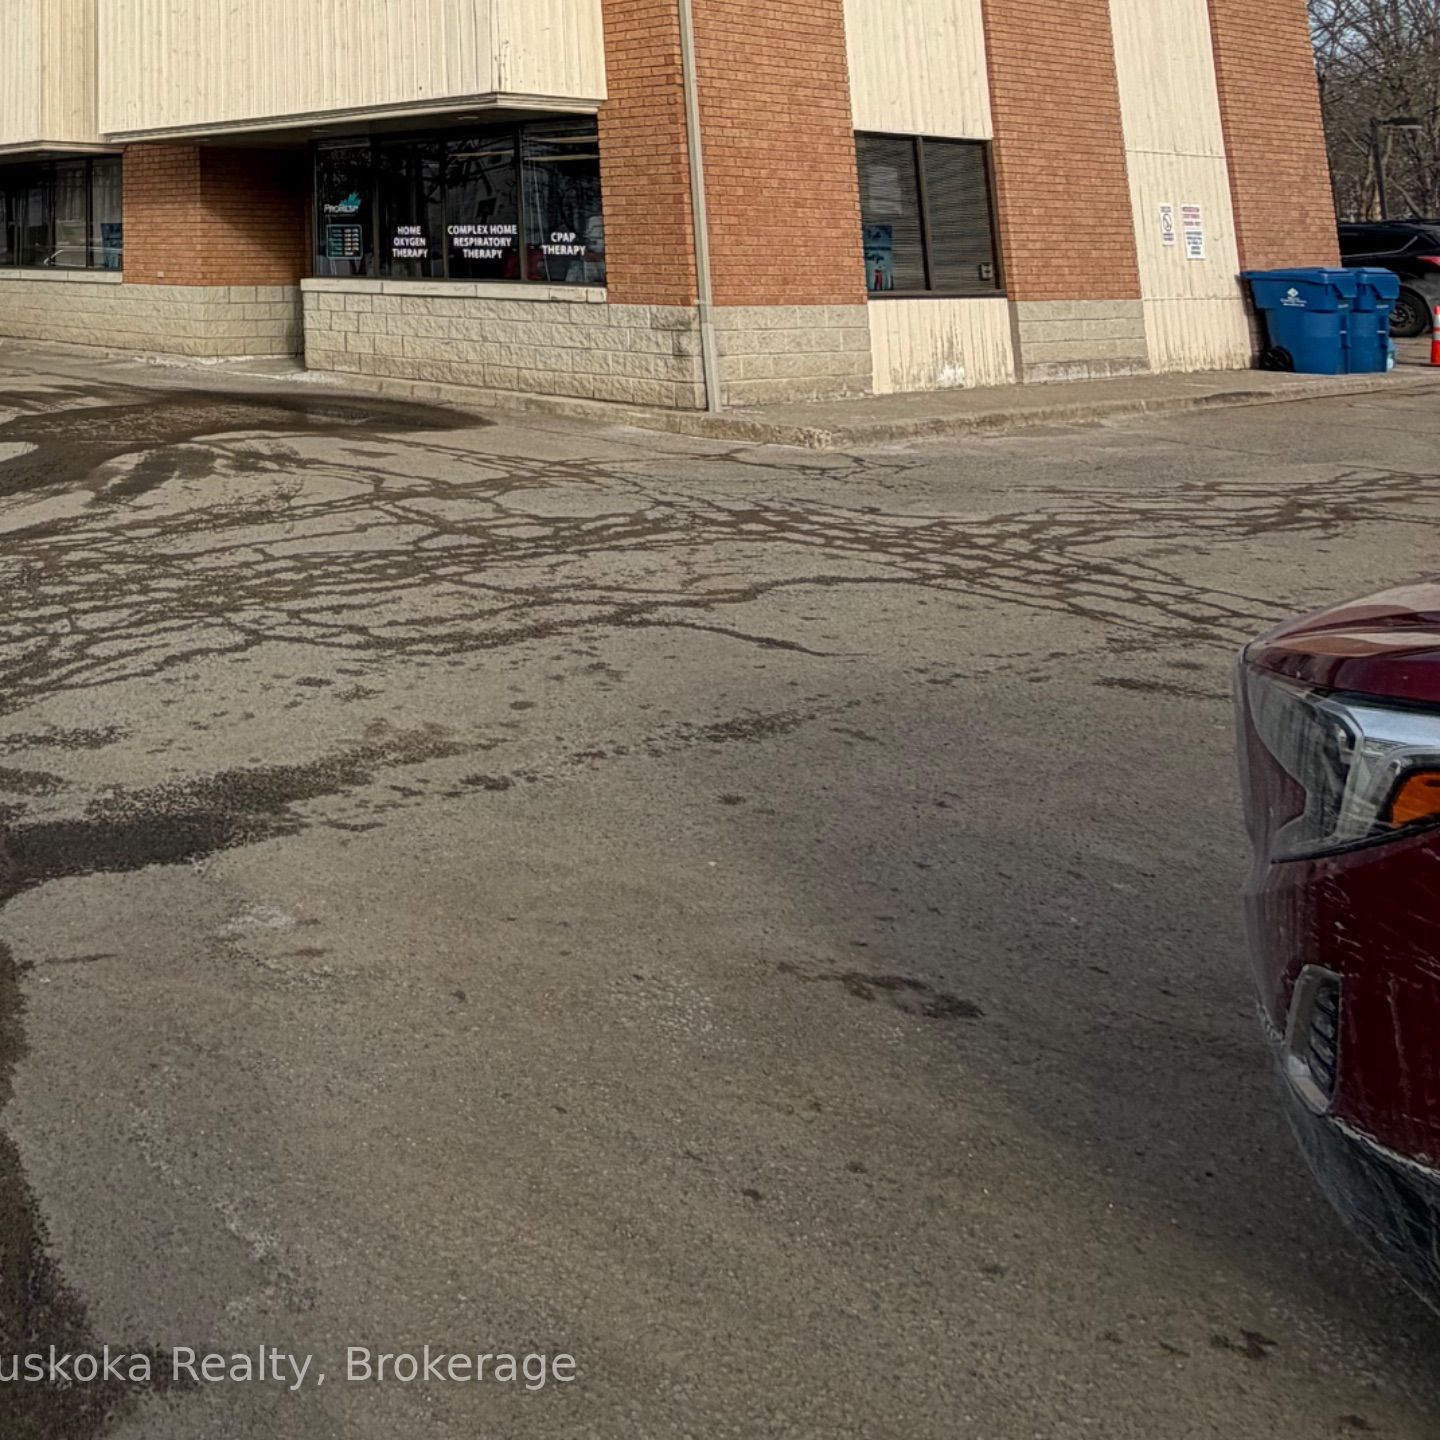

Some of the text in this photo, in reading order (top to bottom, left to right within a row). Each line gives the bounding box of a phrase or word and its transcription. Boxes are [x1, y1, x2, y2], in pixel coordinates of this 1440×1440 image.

[397, 226, 421, 234] HOME
[447, 225, 517, 235] COMPLEX HOME
[393, 237, 426, 246] OXYGEN
[453, 237, 512, 247] RESPIRATORY
[550, 232, 576, 242] CPAP
[392, 248, 428, 258] THERAPY
[462, 249, 503, 259] THERAPY
[542, 245, 586, 255] THERAPY
